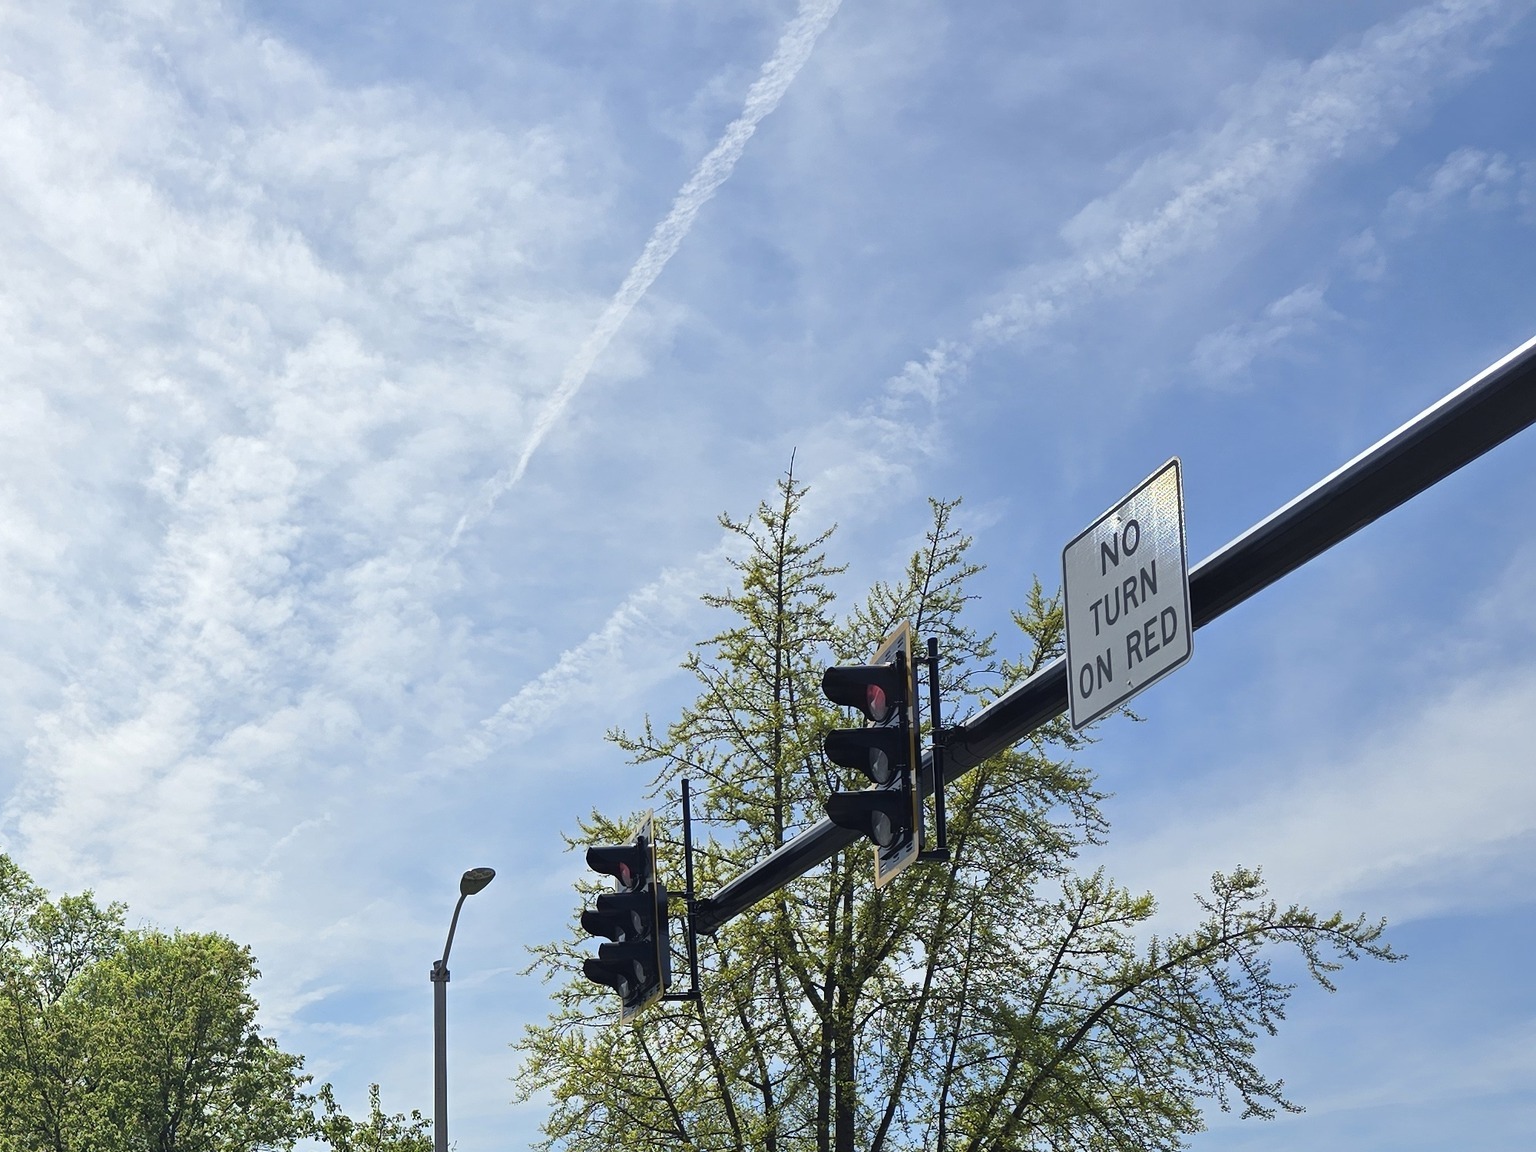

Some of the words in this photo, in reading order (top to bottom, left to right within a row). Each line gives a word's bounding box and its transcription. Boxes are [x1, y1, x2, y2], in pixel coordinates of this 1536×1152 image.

[1100, 519, 1140, 576] NO
[1089, 560, 1157, 636] TURN
[1079, 648, 1113, 699] ON
[1125, 606, 1178, 670] RED
